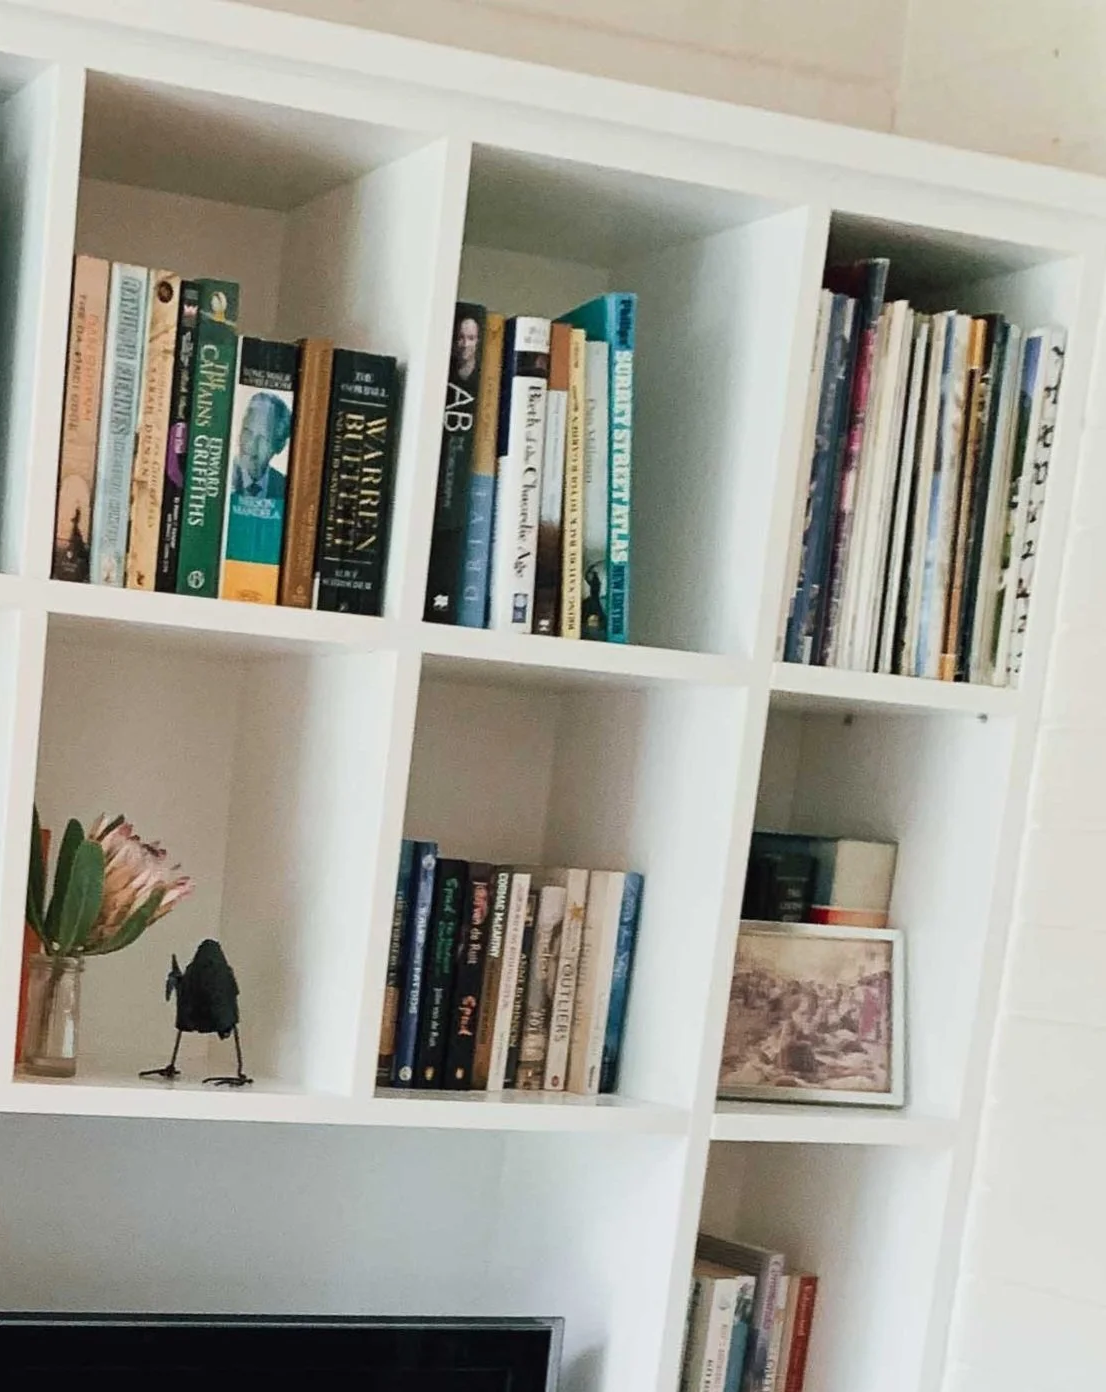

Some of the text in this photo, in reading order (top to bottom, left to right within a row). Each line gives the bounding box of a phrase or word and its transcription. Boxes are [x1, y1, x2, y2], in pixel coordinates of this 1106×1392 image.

[195, 343, 221, 426] CAPTAINS
[211, 362, 231, 391] THE
[443, 382, 475, 431] AB
[525, 386, 543, 427] Birth
[613, 349, 634, 425] SURREY
[187, 434, 211, 527] GRIFFITHS
[205, 436, 224, 498] EDWARD
[354, 416, 388, 553] WARREN
[612, 428, 633, 502] STREET
[513, 545, 532, 579] Age
[611, 503, 632, 563] ATLAS
[612, 565, 626, 590] NEW
[469, 927, 483, 942] de
[489, 872, 509, 958] CORMAC McCARTHY
[466, 943, 483, 965] Ruit
[457, 994, 478, 1037] Spud
[553, 963, 576, 1043] OUTLIERS
